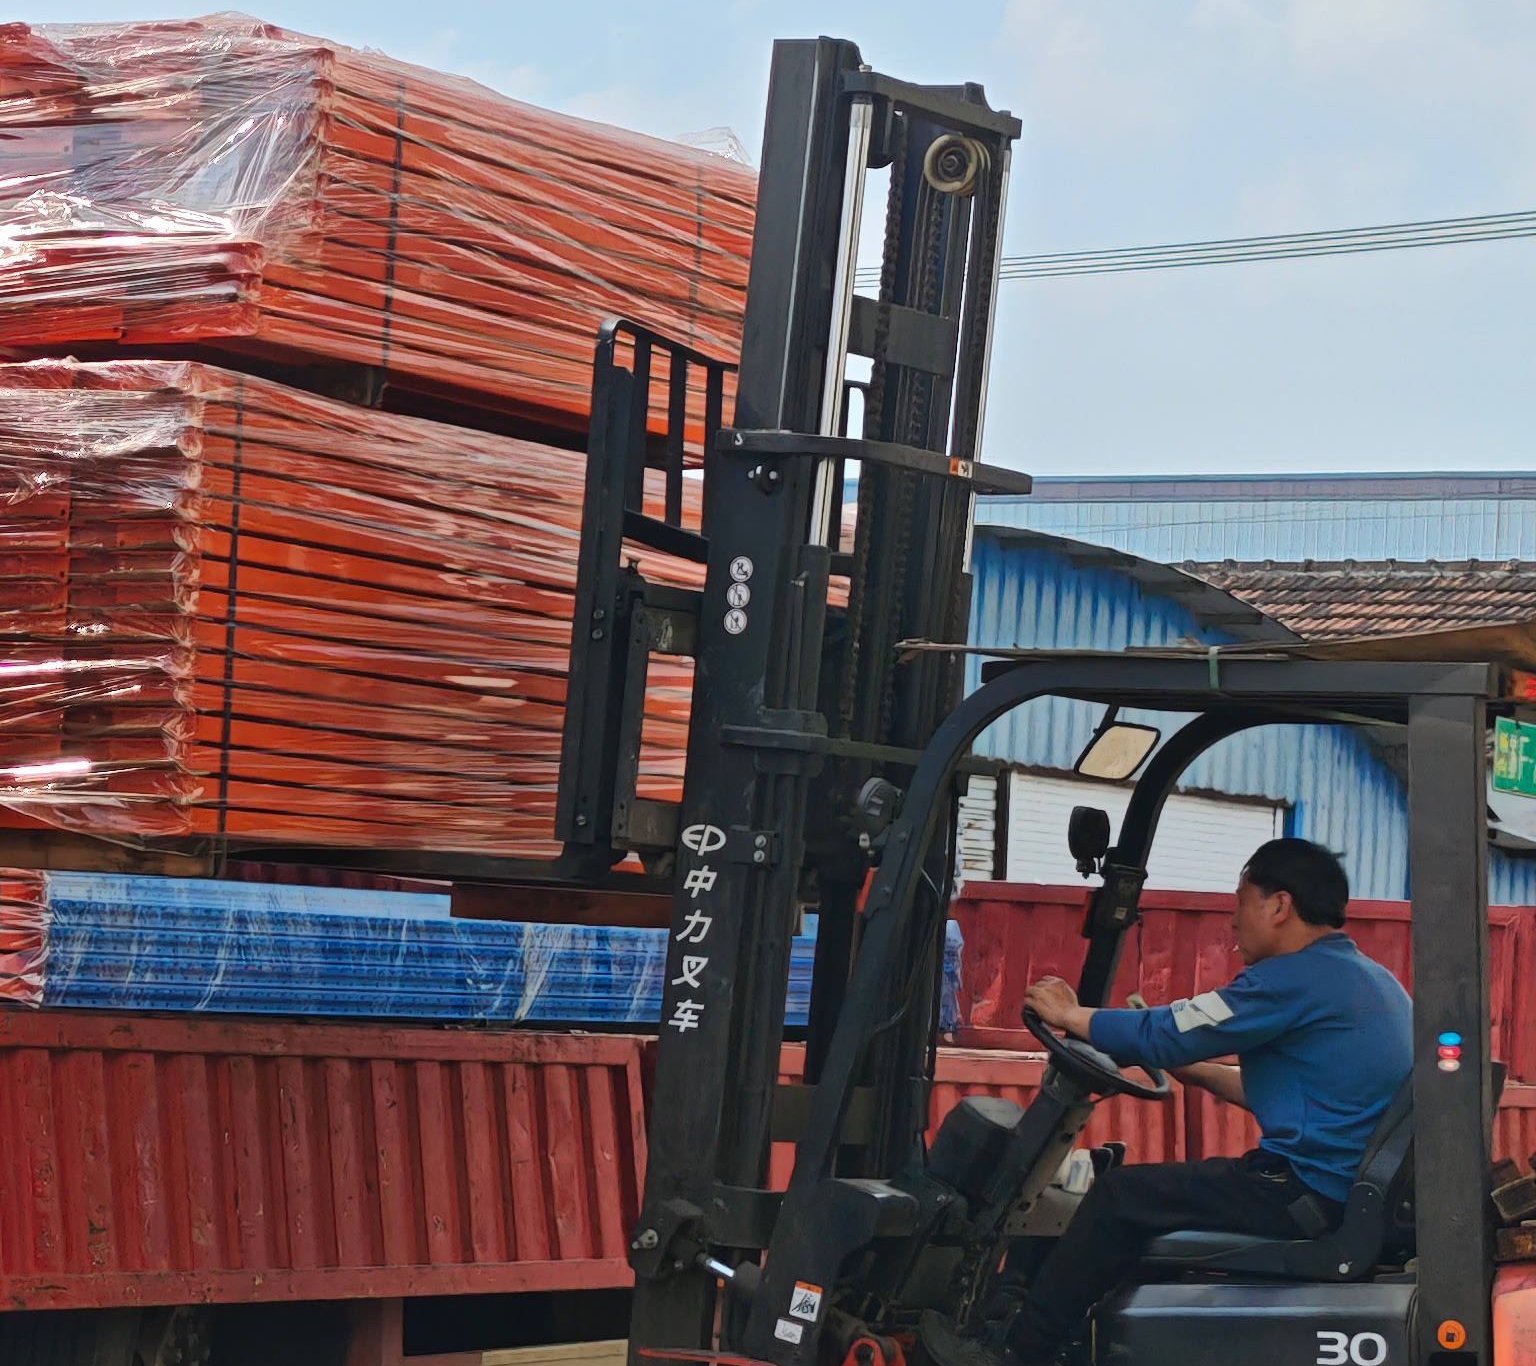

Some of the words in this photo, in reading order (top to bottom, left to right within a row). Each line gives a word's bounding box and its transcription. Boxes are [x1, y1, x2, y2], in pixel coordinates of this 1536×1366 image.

[668, 864, 717, 1033] 中力叉车
[1316, 1330, 1388, 1366] 30
